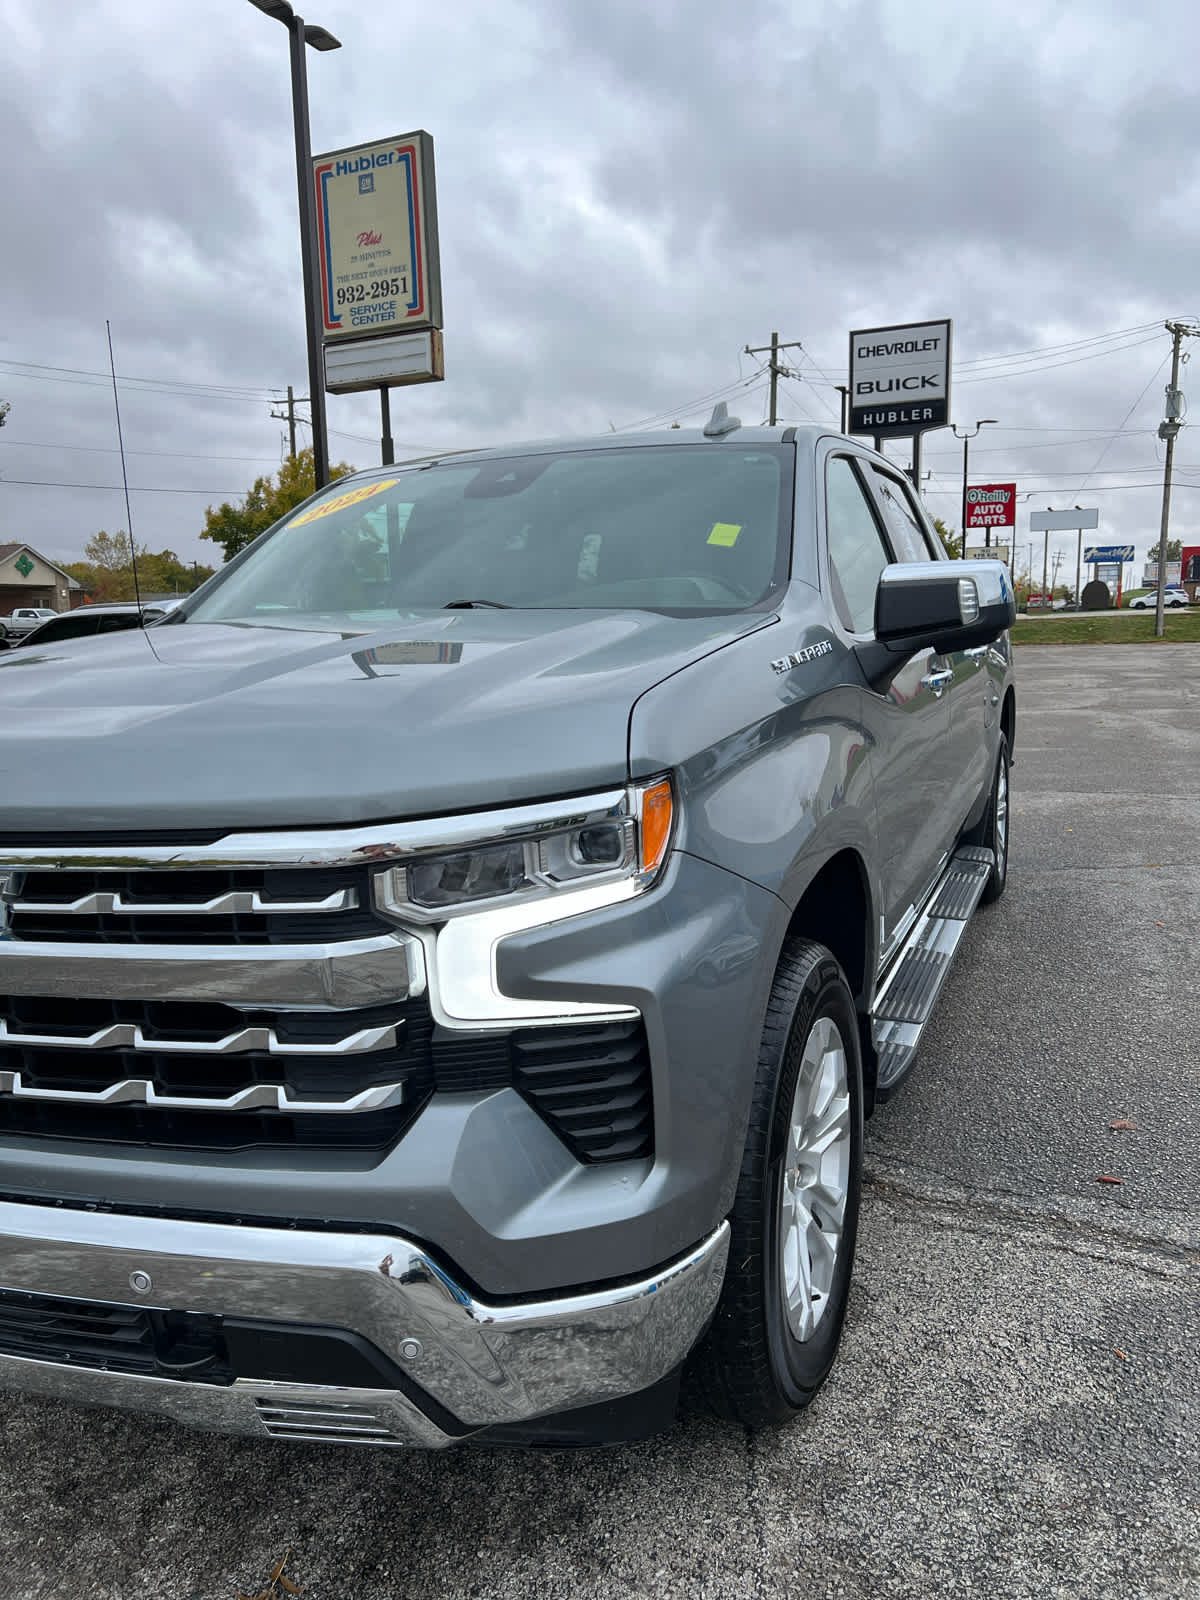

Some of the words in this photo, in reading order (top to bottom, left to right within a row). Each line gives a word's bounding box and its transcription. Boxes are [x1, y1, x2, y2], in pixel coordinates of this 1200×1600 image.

[336, 151, 395, 176] Hubler
[356, 229, 383, 248] Plus
[336, 273, 350, 284] THE
[337, 276, 408, 305] 932-2951
[349, 300, 397, 317] SERVICE
[351, 311, 396, 327] CENTER
[857, 338, 941, 359] CHEVROLET
[856, 374, 940, 395] BUICK
[863, 408, 933, 425] HUBLER
[968, 489, 1010, 504] O'Reilly
[973, 504, 1004, 515] AUTO
[970, 515, 1007, 526] PARTS
